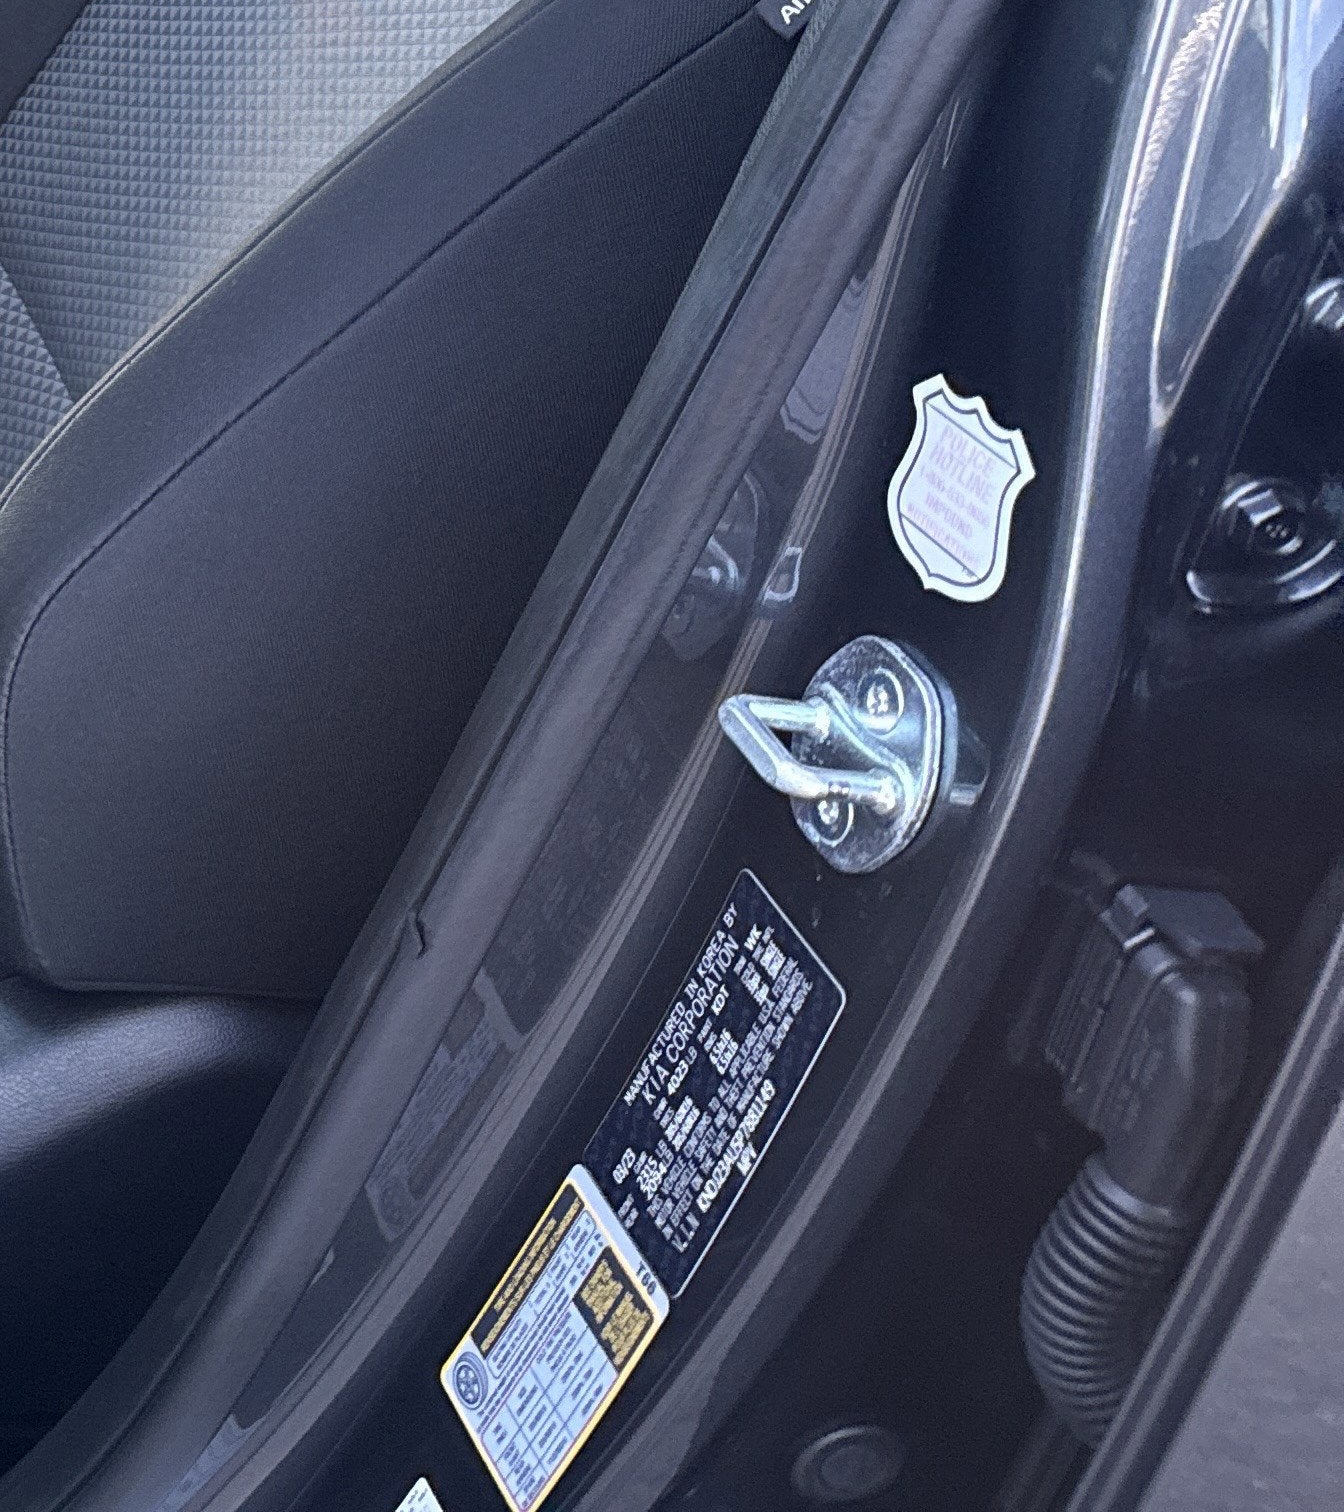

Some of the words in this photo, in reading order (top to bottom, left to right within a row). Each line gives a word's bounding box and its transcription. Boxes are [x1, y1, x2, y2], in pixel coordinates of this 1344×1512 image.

[613, 1148, 637, 1184] 03/23
[667, 1060, 688, 1095] 4023
[685, 1046, 697, 1064] LB
[711, 984, 729, 1016] KDT
[744, 923, 762, 950] WK
[624, 1002, 685, 1106] MANUFACTURED
[684, 978, 698, 1000] IN
[697, 930, 726, 978] KOREA
[723, 902, 737, 928] BY
[642, 1065, 669, 1105] KIA
[666, 934, 739, 1063] CORPORATION
[672, 1159, 697, 1199] VEHICLE
[694, 1126, 716, 1162] SAFETY
[714, 1106, 728, 1129] AND
[724, 1078, 744, 1108] THEFT
[741, 1021, 776, 1080] PREVENTION
[772, 968, 804, 1022] STANDARDS
[636, 1156, 657, 1192] 2315
[655, 1140, 667, 1158] LB
[661, 1156, 686, 1194] VEHICLE
[708, 1097, 720, 1112] TO
[718, 1080, 731, 1099] ALL
[729, 1022, 761, 1079] APPLICABLE
[662, 1149, 674, 1168] LB
[670, 1188, 693, 1227] EFFECT
[712, 1128, 730, 1156] DATE
[727, 1111, 737, 1129] OF
[736, 1048, 775, 1114] MANUFACTURE
[772, 1013, 793, 1049] SHOWN
